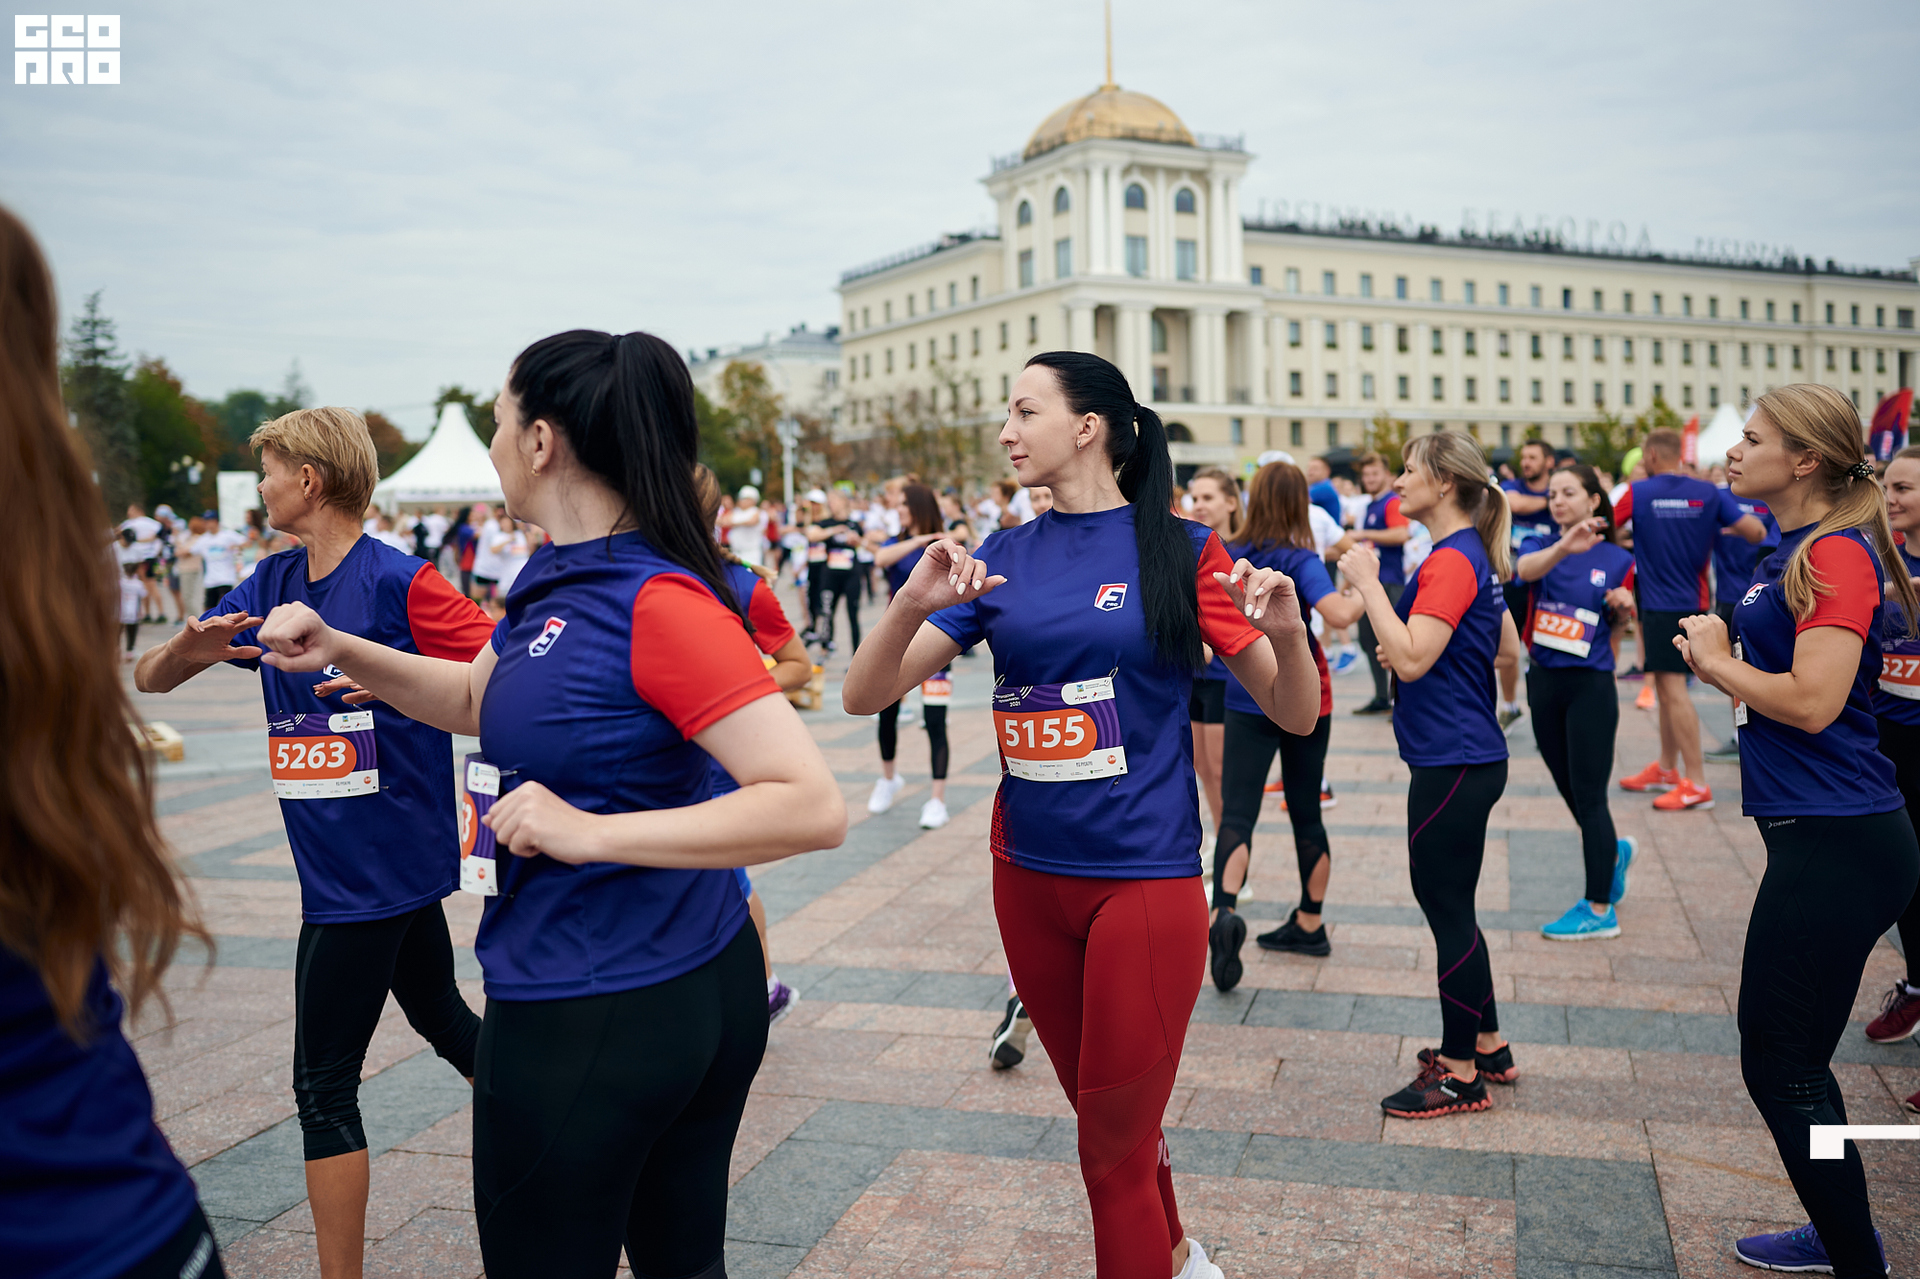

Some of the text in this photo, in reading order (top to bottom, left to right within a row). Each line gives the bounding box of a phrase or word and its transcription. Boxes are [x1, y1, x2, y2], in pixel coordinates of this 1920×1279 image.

[1537, 613, 1581, 638] 5271
[1882, 657, 1920, 678] 527
[1005, 715, 1085, 748] 5155
[276, 741, 346, 769] 5263
